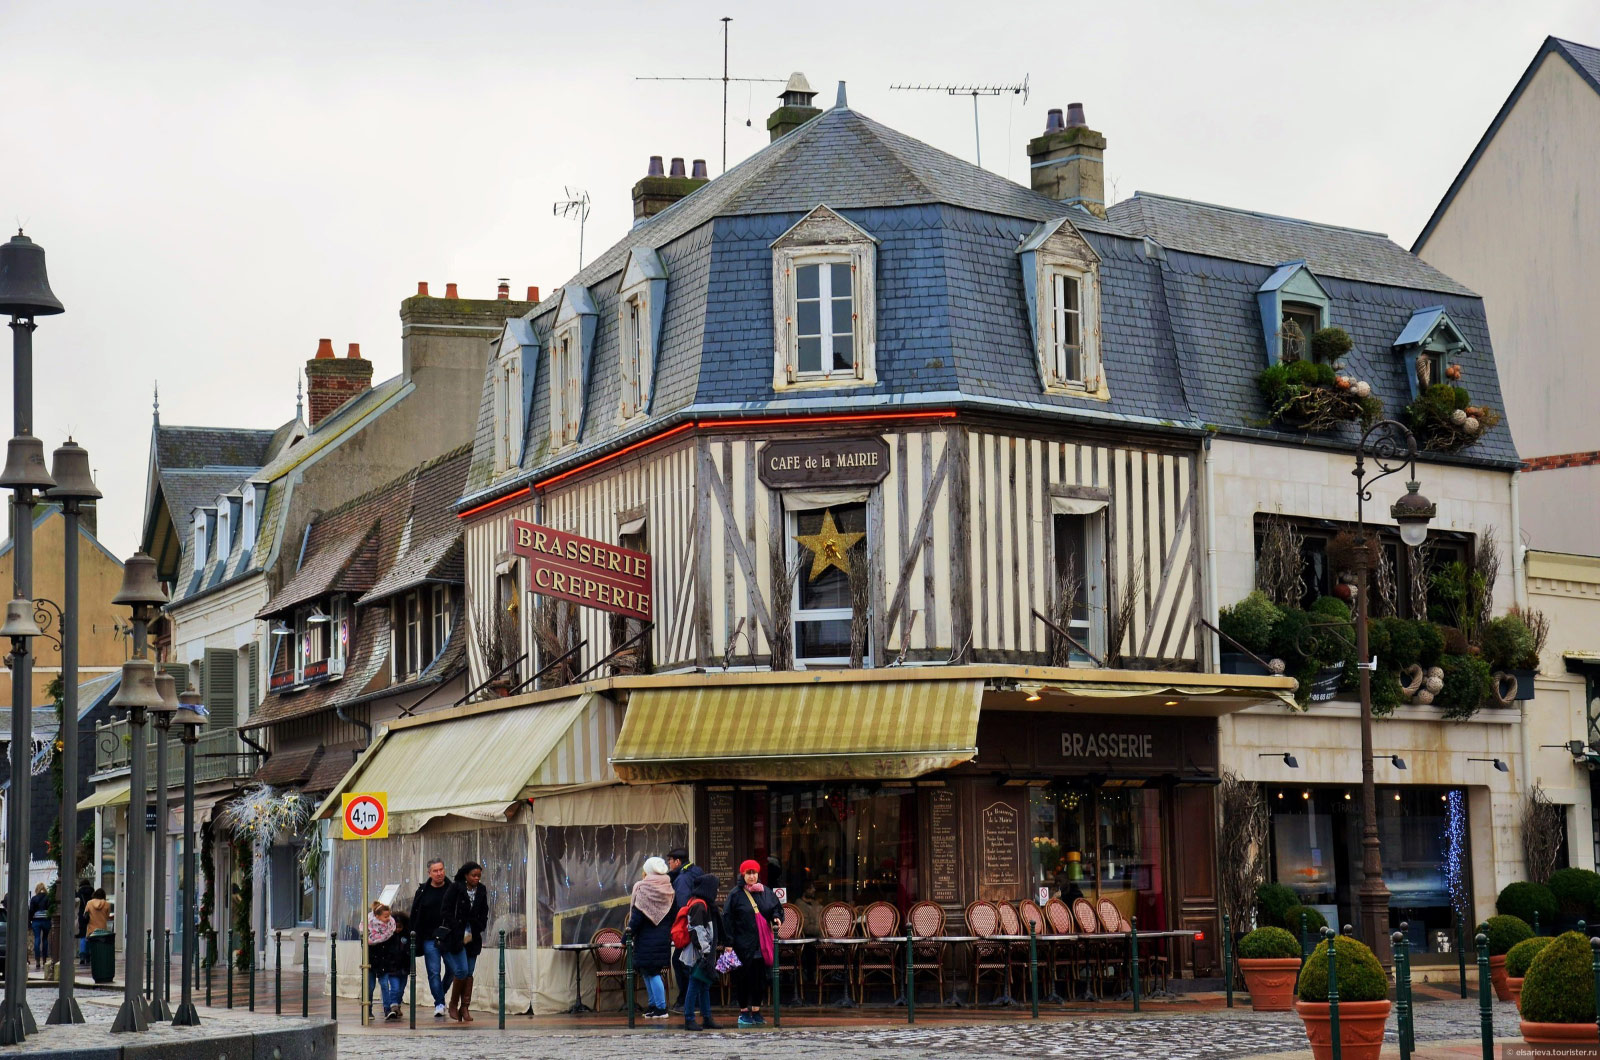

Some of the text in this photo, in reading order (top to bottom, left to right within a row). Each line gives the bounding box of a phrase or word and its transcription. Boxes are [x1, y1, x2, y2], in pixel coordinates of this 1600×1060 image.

[770, 452, 878, 470] CAFE de la MAIRIE
[517, 526, 647, 579] BRASSERIE
[535, 567, 649, 616] CREPERIE
[1061, 732, 1153, 758] BRASSERIE
[625, 762, 758, 782] BRASSERIE
[825, 760, 856, 777] LA
[873, 757, 953, 776] MAIRI
[352, 808, 377, 825] 4,1m
